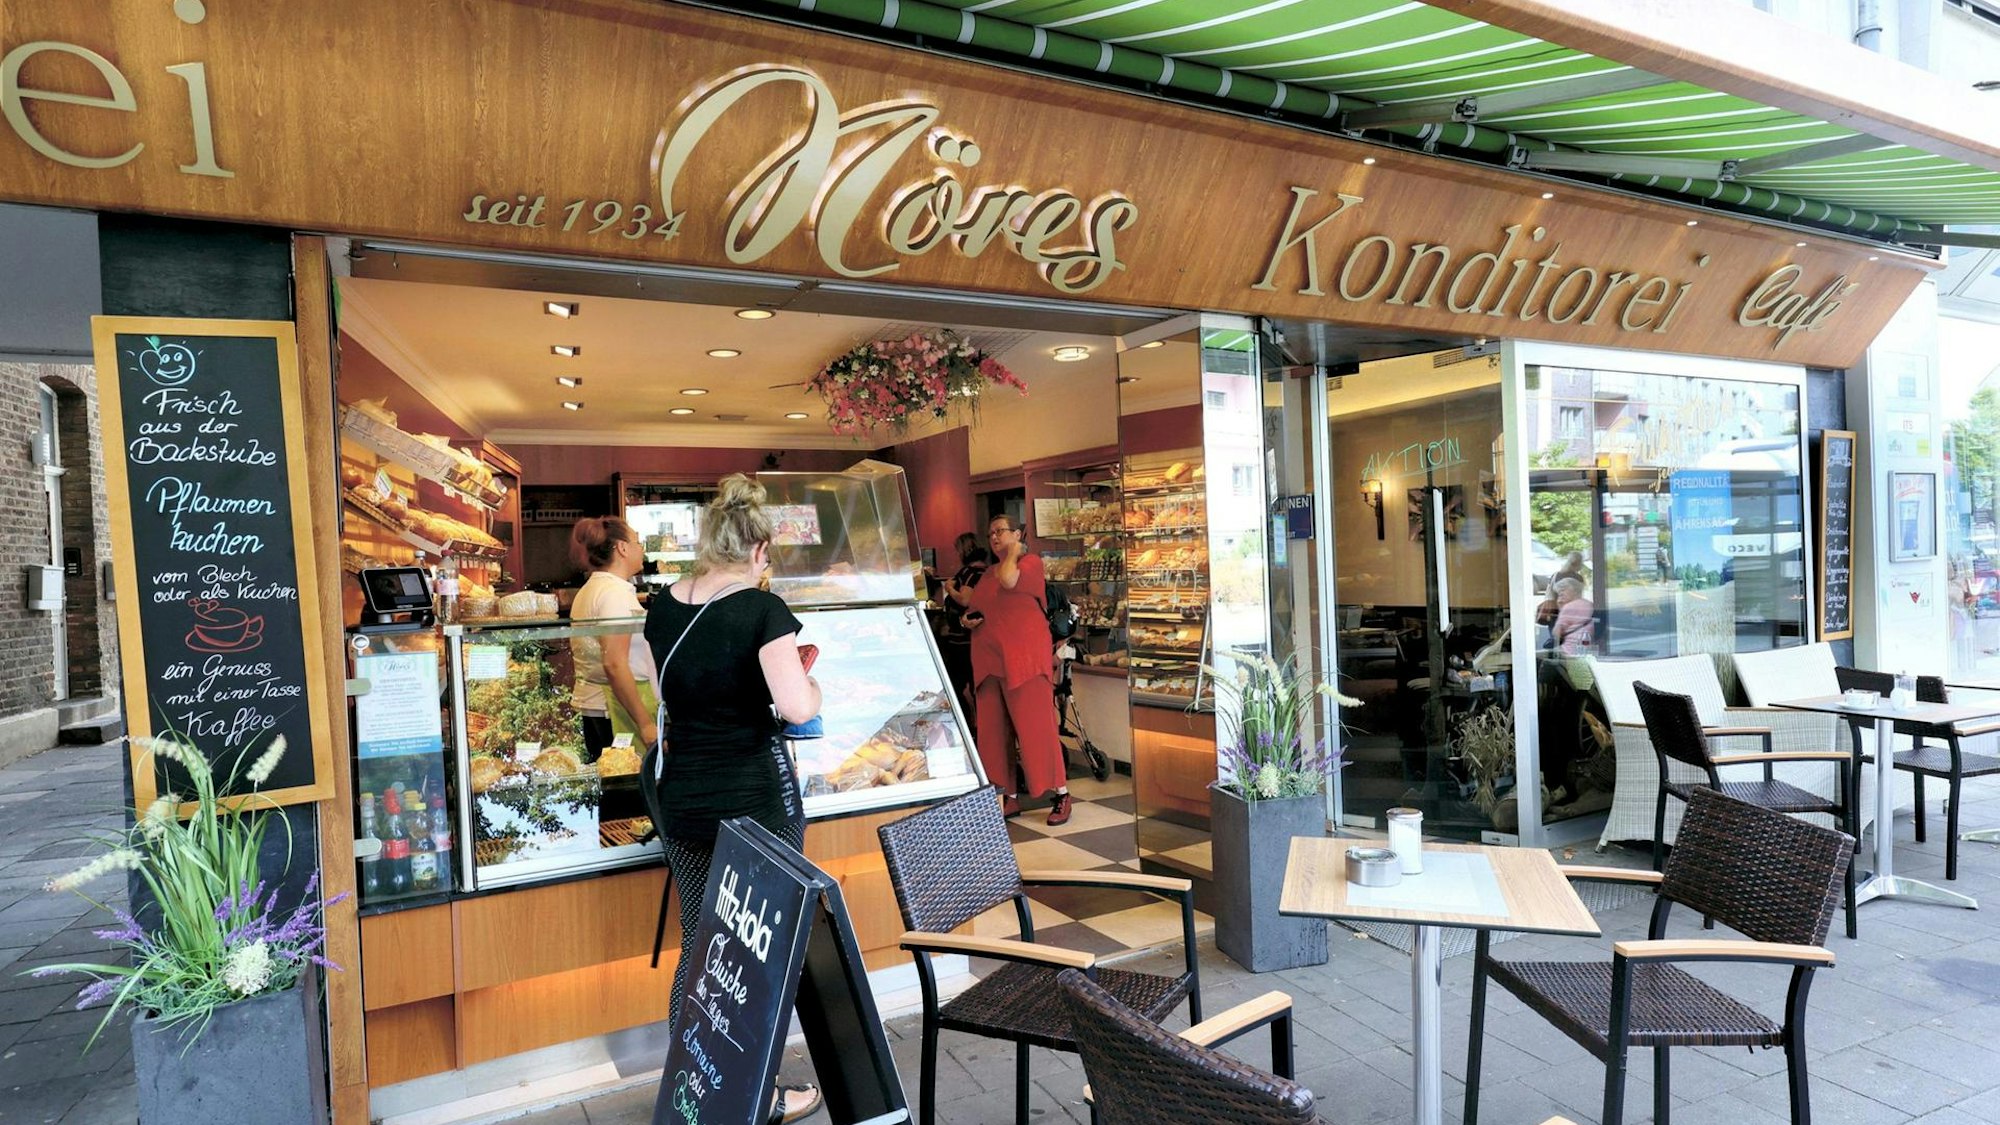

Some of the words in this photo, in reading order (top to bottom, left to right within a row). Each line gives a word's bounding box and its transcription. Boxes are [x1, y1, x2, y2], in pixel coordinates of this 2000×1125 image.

[463, 195, 546, 229] seit
[561, 199, 688, 242] 1934
[1250, 186, 1710, 334] Konditorei
[1738, 264, 1860, 352] Café
[142, 387, 242, 415] Frisch
[139, 422, 182, 435] aus
[198, 417, 238, 435] der
[129, 437, 277, 466] Backstube
[1361, 437, 1463, 482] AKTION
[146, 476, 276, 525] Pflaumen
[152, 571, 188, 585] vom
[198, 564, 258, 584] Blech
[153, 589, 191, 603] oder
[200, 584, 229, 600] als
[161, 661, 193, 680] ein
[197, 654, 272, 693] Genuss
[166, 690, 205, 705] mit
[213, 687, 258, 704] einer
[256, 676, 301, 698] Tasse
[178, 708, 276, 747] Kaffee
[705, 933, 748, 1005] Quiche
[707, 992, 730, 1033] Tages
